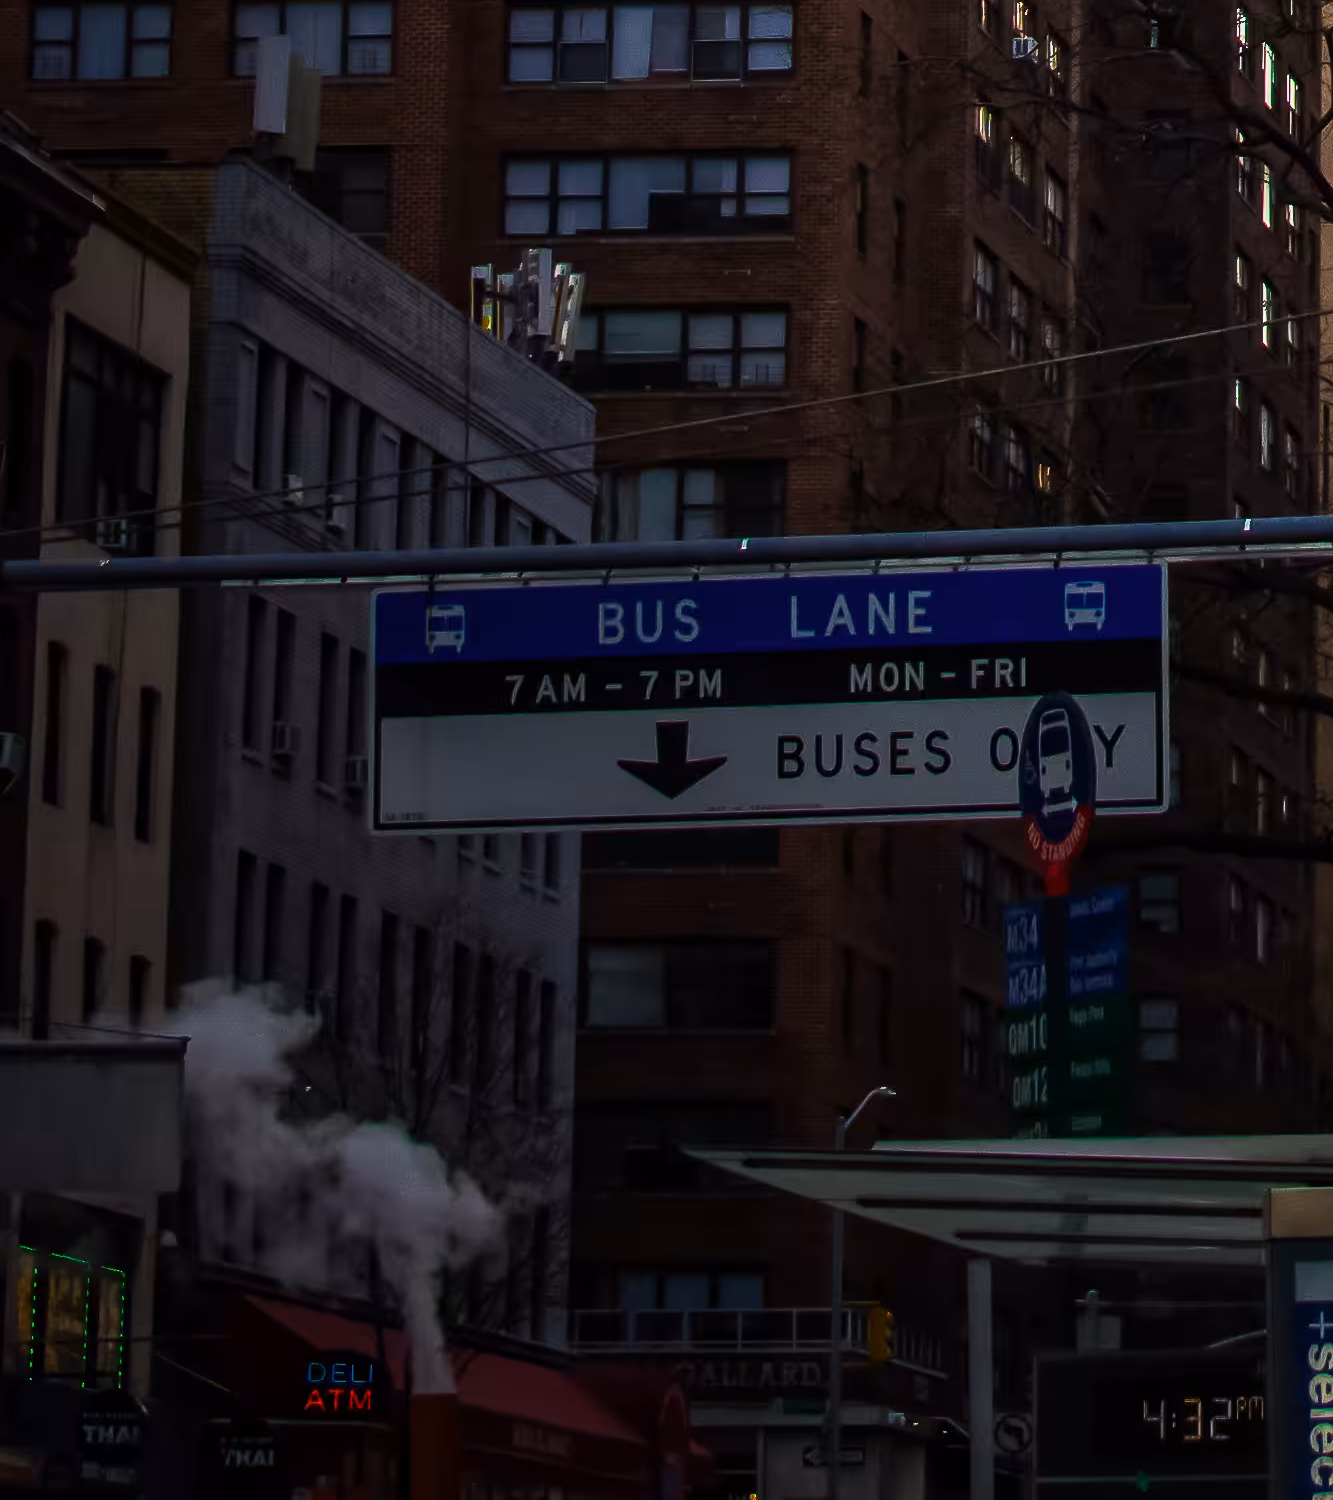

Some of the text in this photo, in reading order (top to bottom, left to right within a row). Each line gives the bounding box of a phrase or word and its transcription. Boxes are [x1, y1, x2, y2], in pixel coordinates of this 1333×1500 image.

[598, 590, 934, 645] BUS LANE
[505, 674, 525, 705] 7
[535, 672, 587, 704] AM
[639, 669, 659, 700] 7
[674, 668, 723, 699] PM
[850, 661, 926, 693] MON
[970, 657, 1027, 689] FRI
[777, 722, 1126, 780] BUSES OY
[1027, 812, 1087, 861] NO STANDING
[307, 1362, 373, 1383] DELI
[304, 1388, 373, 1412] ATM
[1142, 1396, 1233, 1443] 4:32
